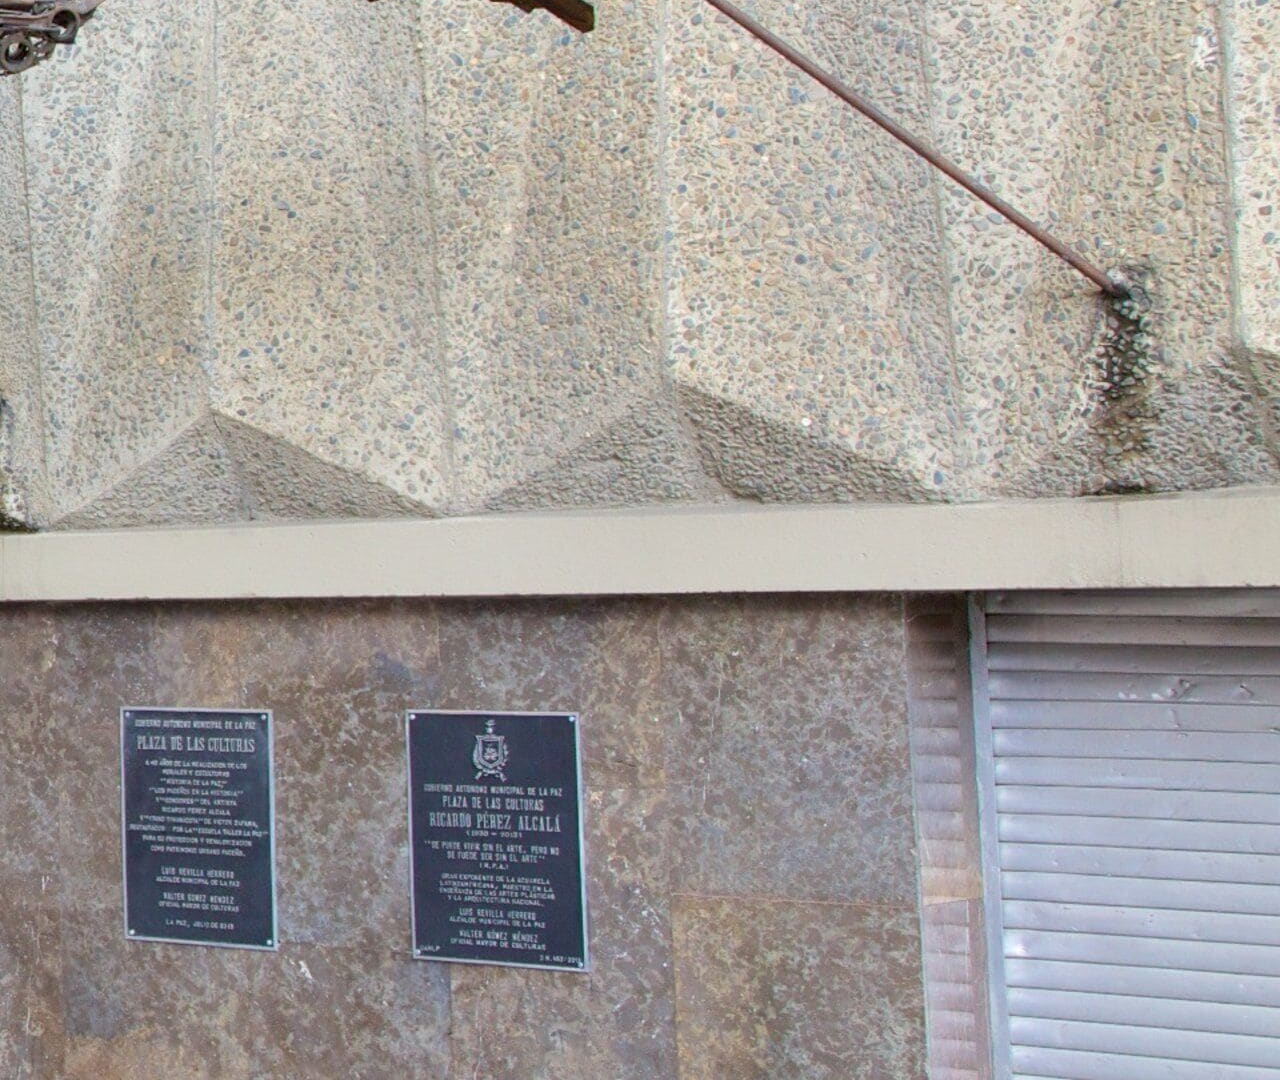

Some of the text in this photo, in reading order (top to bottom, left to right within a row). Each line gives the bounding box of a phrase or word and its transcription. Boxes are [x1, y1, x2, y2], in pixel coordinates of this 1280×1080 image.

[136, 735, 256, 753] PLAZA DE LAS CULTURAS
[527, 787, 537, 796] DE
[539, 787, 548, 796] LA
[550, 787, 563, 797] PAZ
[442, 795, 545, 811] PLAZA DE LAS CULTURAS
[429, 810, 562, 833] RICARDO PÉREZ ALCALÁ
[459, 907, 473, 917] LUIS
